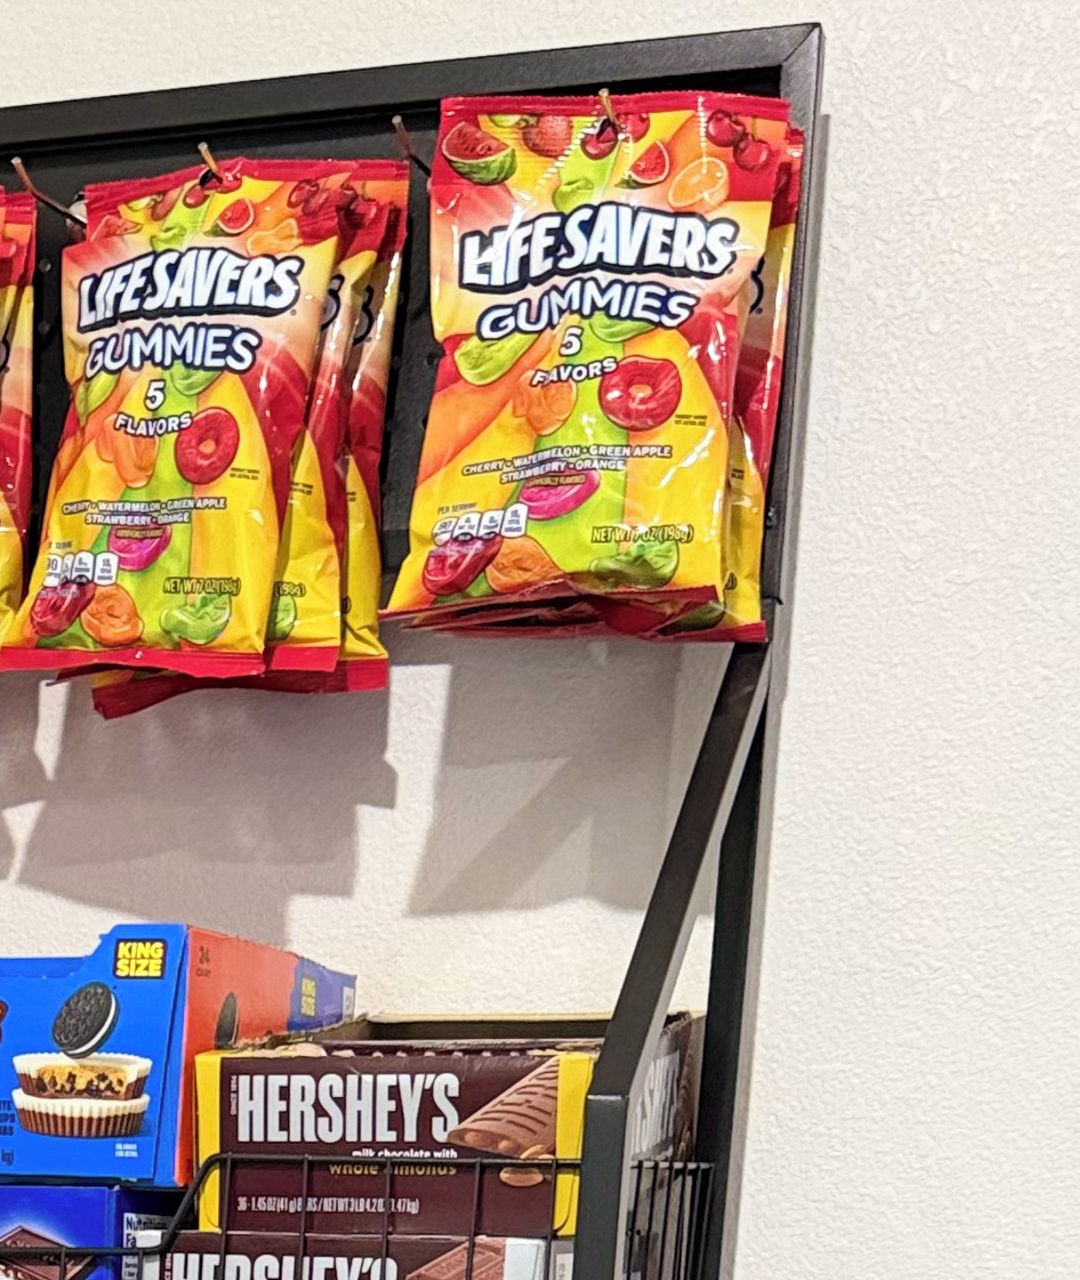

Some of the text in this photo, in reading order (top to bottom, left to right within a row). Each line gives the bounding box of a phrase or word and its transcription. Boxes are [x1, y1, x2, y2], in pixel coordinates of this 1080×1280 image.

[461, 204, 738, 287] LIFE SAVERS
[78, 250, 302, 329] LIFE SAVERS
[479, 279, 698, 339] GUMMIES
[86, 323, 261, 379] GUMMIES
[560, 328, 582, 356] 5
[145, 380, 164, 410] 5
[115, 412, 193, 436] FLAVORS
[462, 444, 672, 475] CHERRY WATERMELON GREEN APPLE
[500, 459, 625, 483] STRAWBERRY ORANGE
[63, 497, 227, 515] CHERRY WATERMELON GREEN APPLE
[85, 513, 151, 525] STRAWBERRY
[592, 527, 612, 542] NET
[117, 940, 165, 959] KING
[116, 958, 163, 978] SIZE
[236, 1073, 459, 1145] HERSHEY'S
